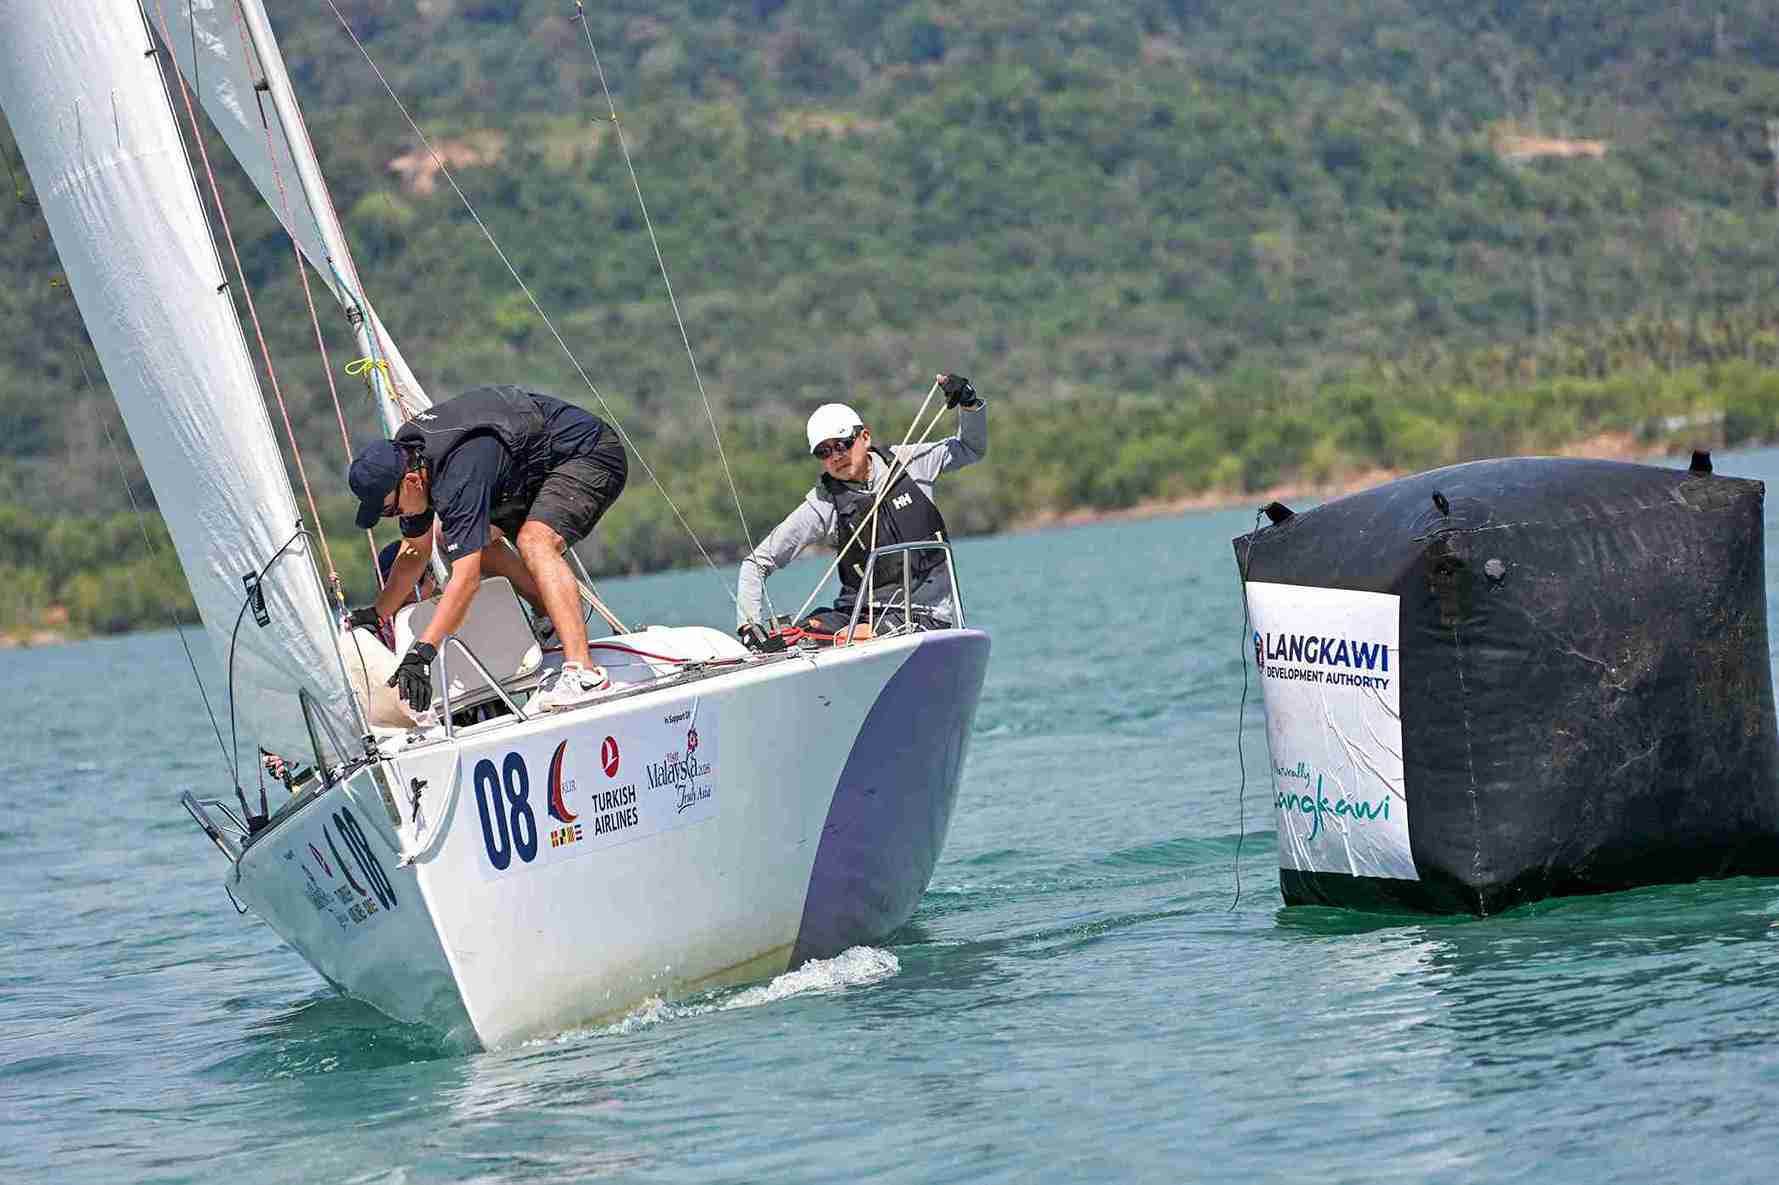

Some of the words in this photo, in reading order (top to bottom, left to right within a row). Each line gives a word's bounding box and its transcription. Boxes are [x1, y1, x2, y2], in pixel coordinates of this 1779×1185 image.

[1266, 632, 1389, 672] LANGKAWI
[1266, 666, 1324, 683] DEVELOPMENT
[1325, 672, 1390, 690] AUTHORITY
[646, 751, 698, 790] Malaysia
[473, 751, 538, 870] 08
[591, 783, 636, 813] TURKISH
[594, 807, 639, 836] AIRLINES
